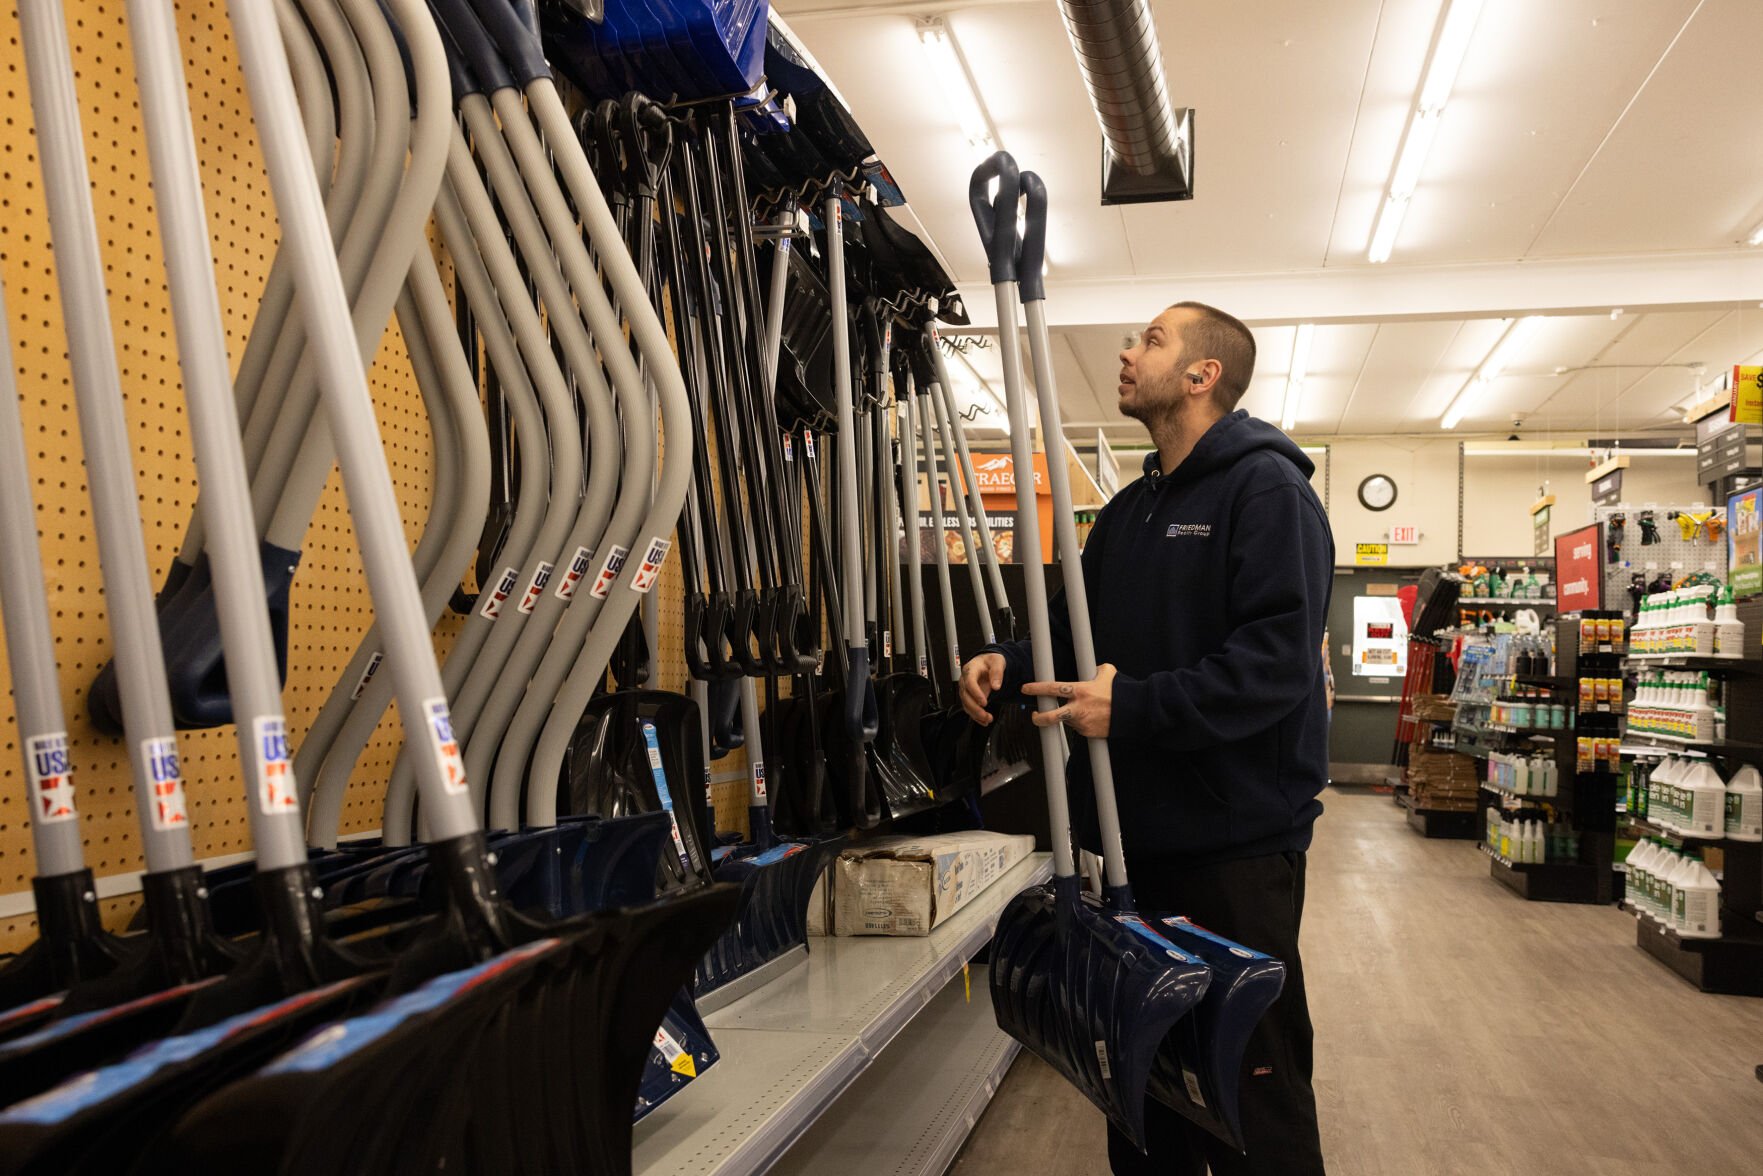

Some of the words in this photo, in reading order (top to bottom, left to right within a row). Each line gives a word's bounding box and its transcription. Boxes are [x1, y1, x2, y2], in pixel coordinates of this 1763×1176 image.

[974, 472, 1042, 485] RAER
[928, 516, 960, 528] ELESS
[1179, 524, 1211, 532] FRIEDMAN
[1394, 527, 1414, 541] EXIT
[1357, 543, 1387, 554] CAUTION
[572, 557, 589, 574] US
[606, 555, 626, 572] US
[263, 734, 290, 761] US
[151, 754, 180, 781] US
[755, 768, 765, 779] US
